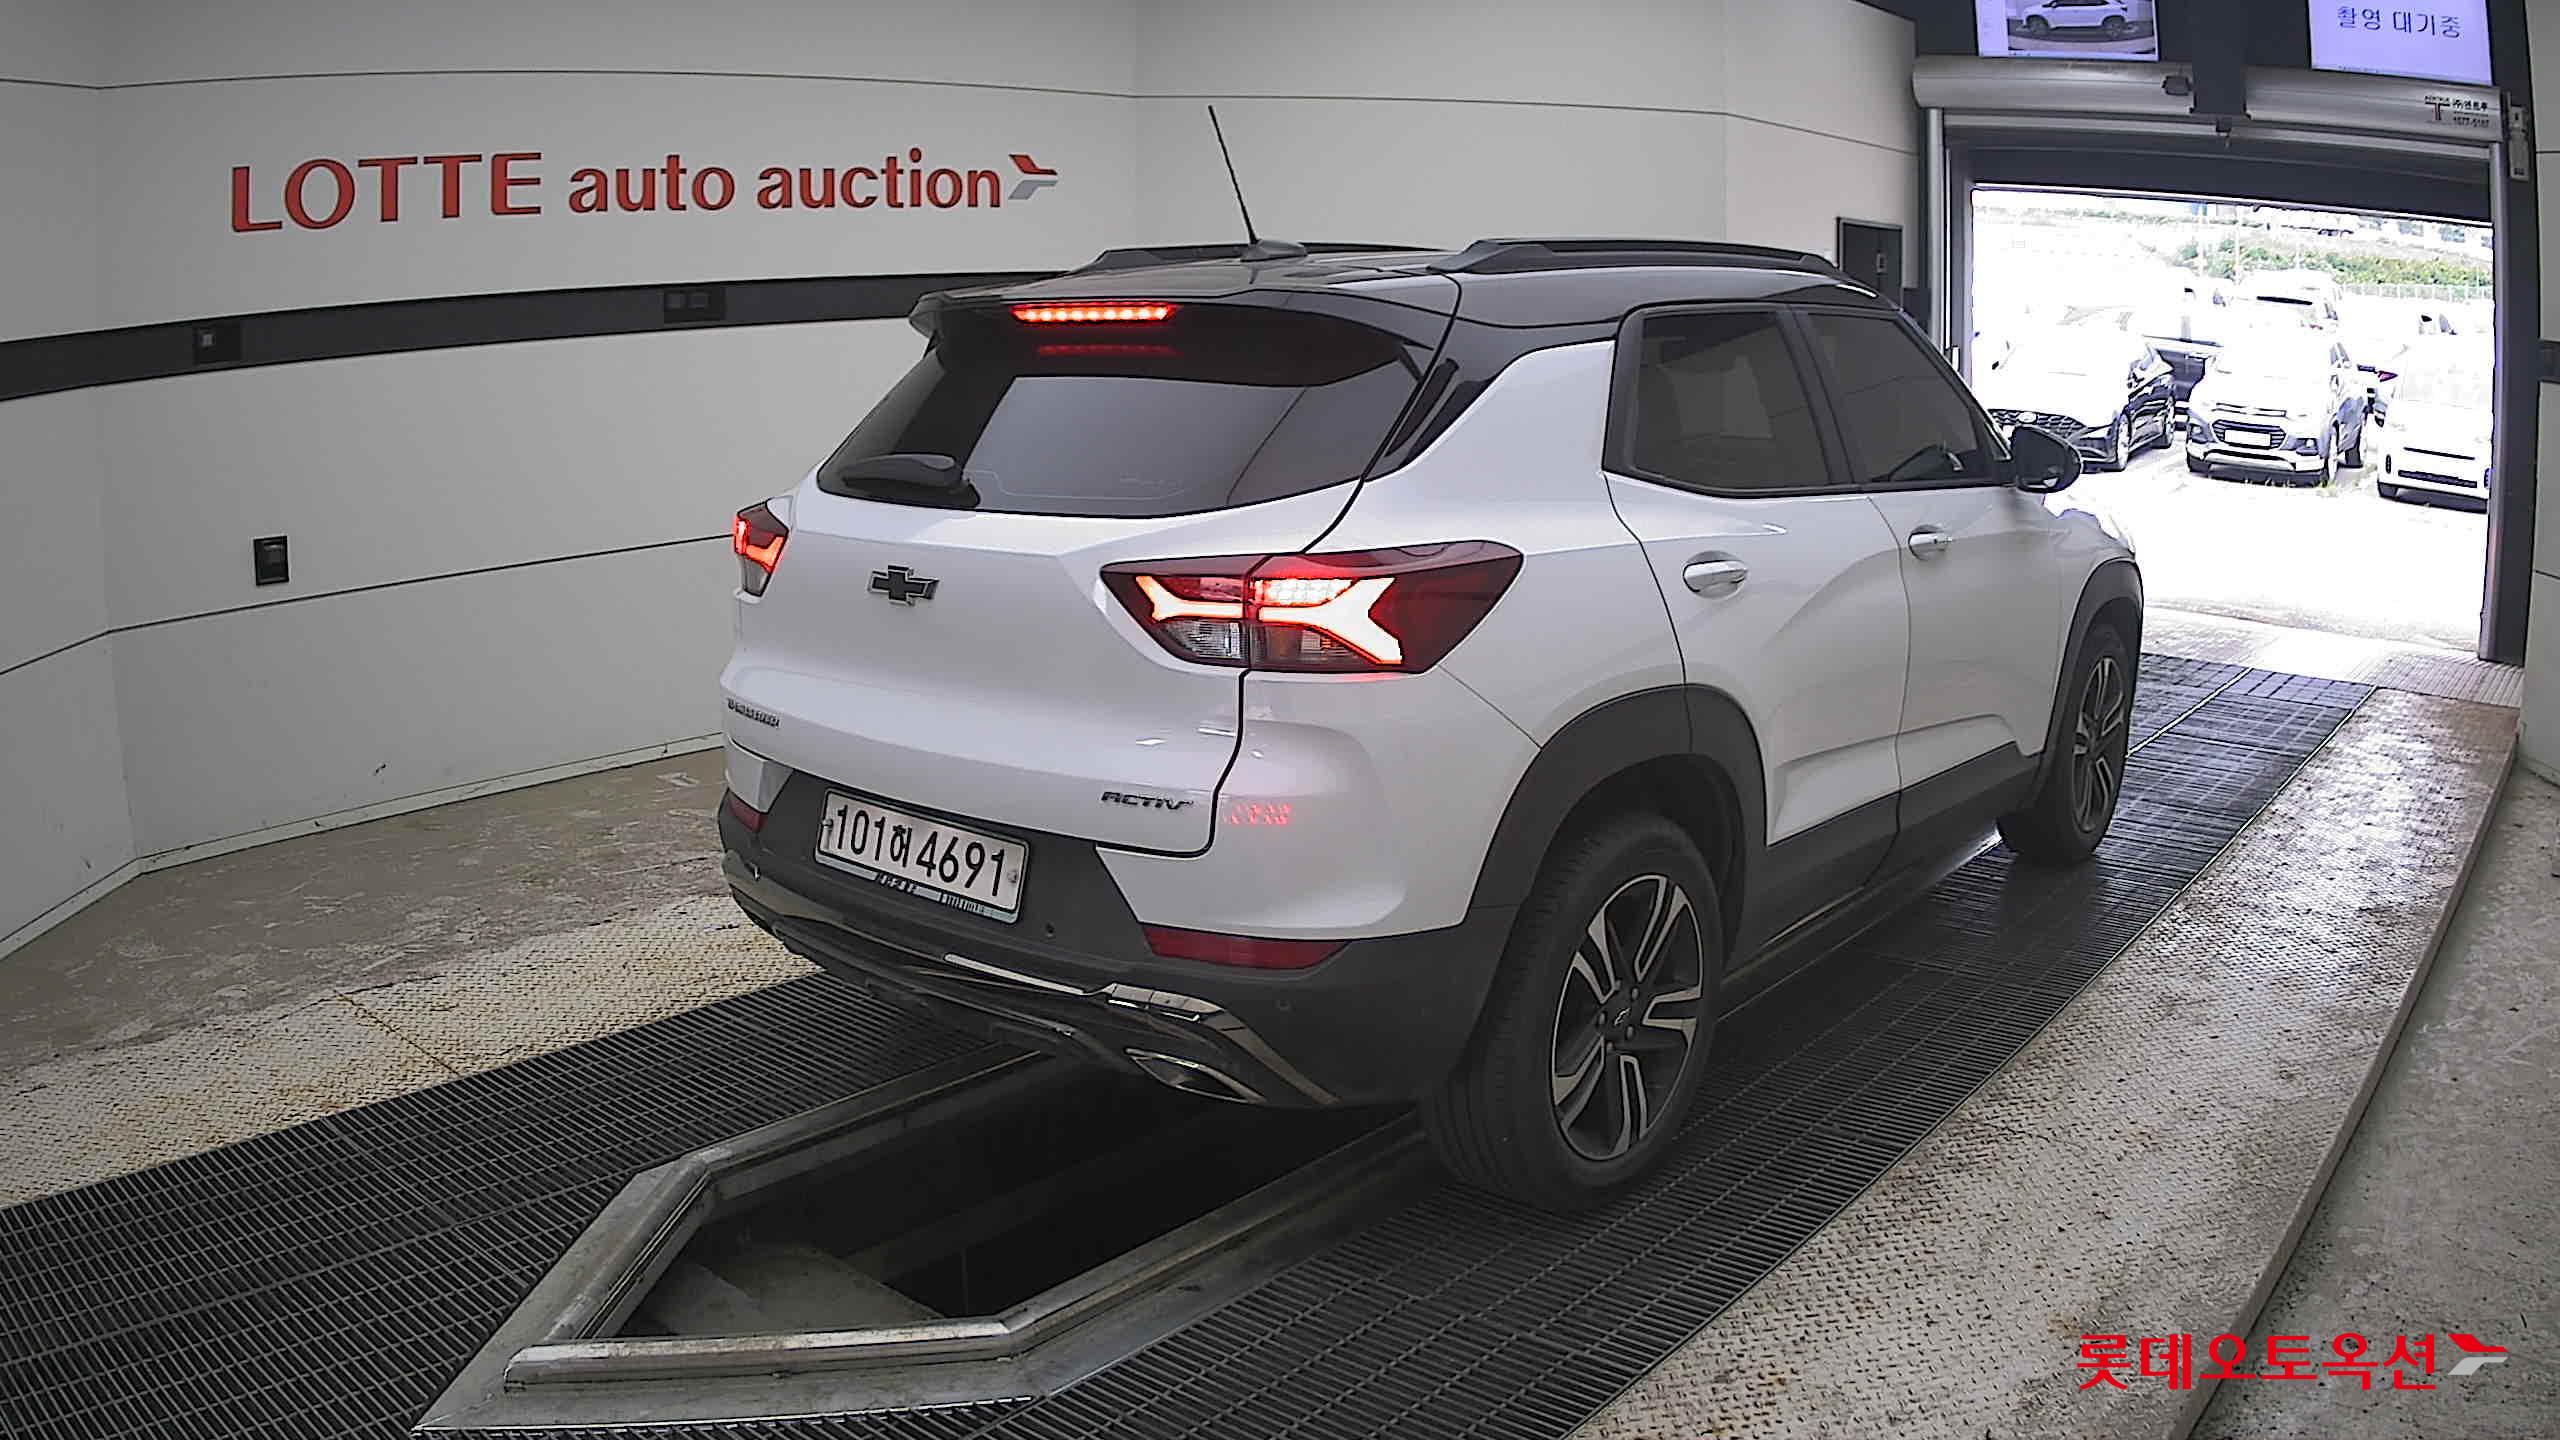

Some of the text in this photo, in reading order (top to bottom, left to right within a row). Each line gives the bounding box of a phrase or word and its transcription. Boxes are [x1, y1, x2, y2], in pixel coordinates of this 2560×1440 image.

[2337, 6, 2460, 39] 촬영 대기중
[230, 147, 1003, 233] LOTTE auto auction
[1100, 791, 1194, 810] ACTIV
[837, 804, 1006, 897] 101허4691
